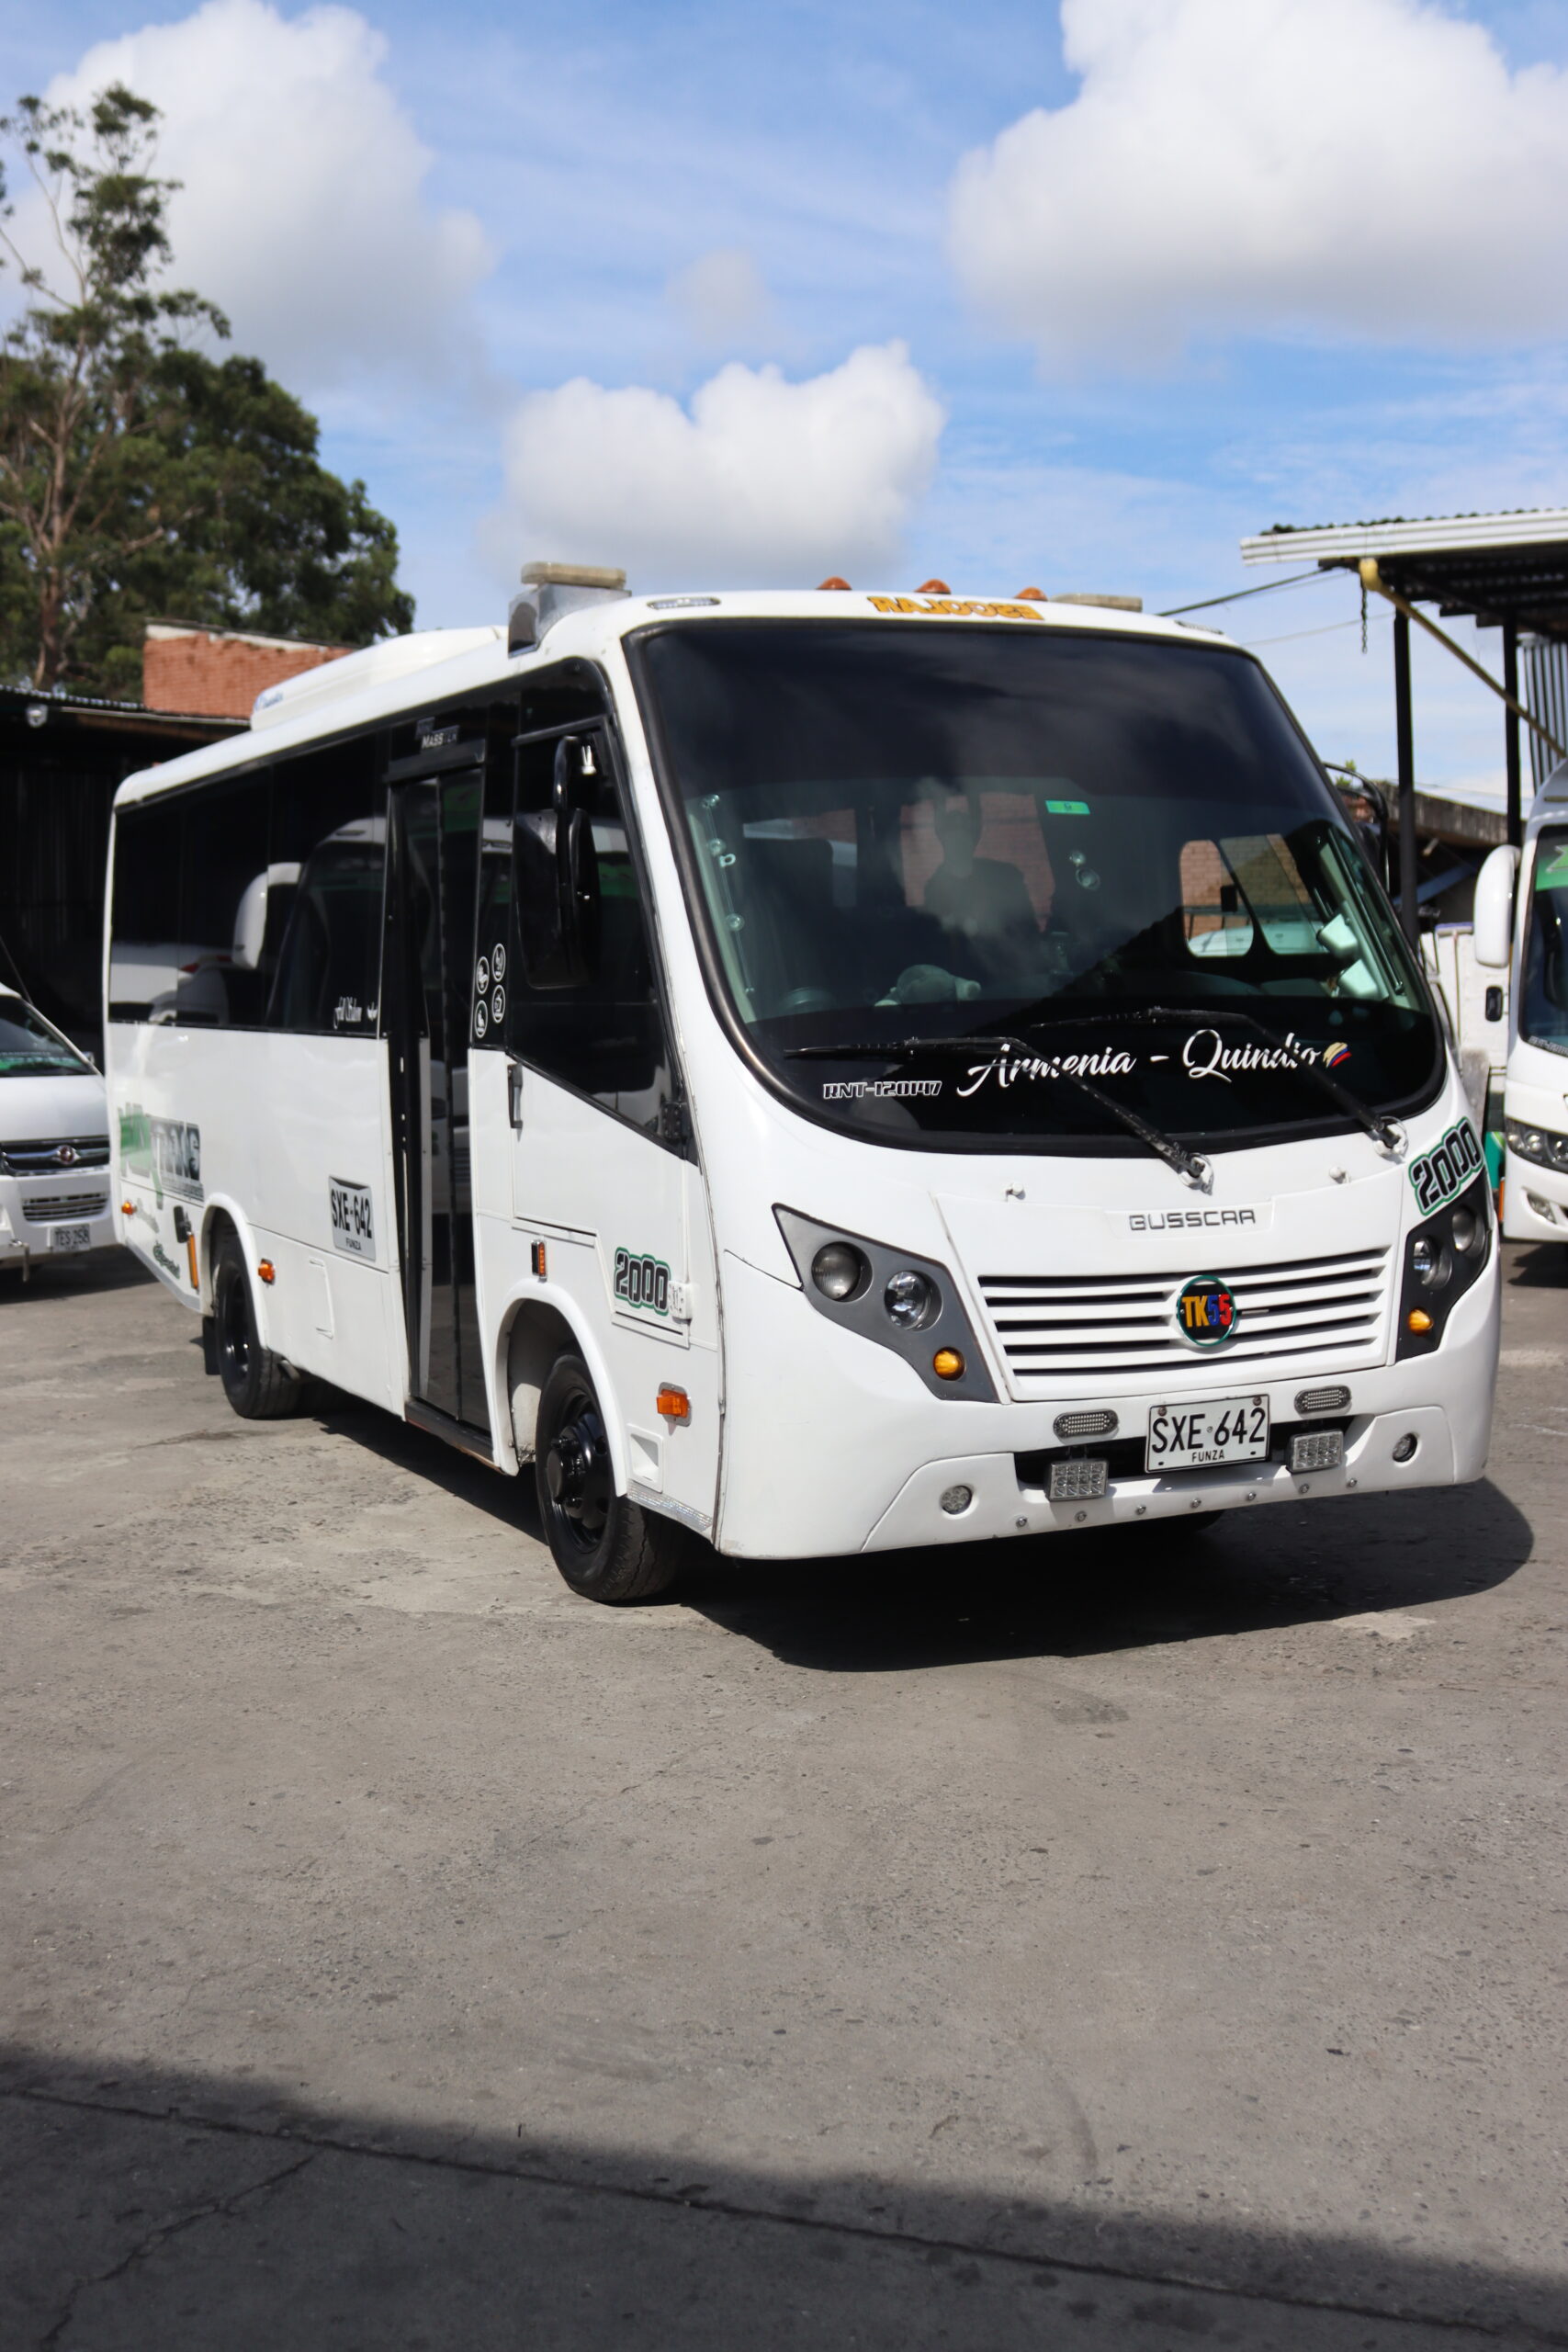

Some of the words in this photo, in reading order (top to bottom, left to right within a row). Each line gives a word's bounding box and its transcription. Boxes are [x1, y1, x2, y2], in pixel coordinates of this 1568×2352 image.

[956, 1044, 1136, 1096] Armenia
[1411, 1119, 1483, 1213] 2000
[1129, 1209, 1256, 1231] BUSSCAR
[615, 1250, 670, 1315] 2000
[1182, 1294, 1232, 1328] TK55
[1191, 1449, 1225, 1463] FUNZA
